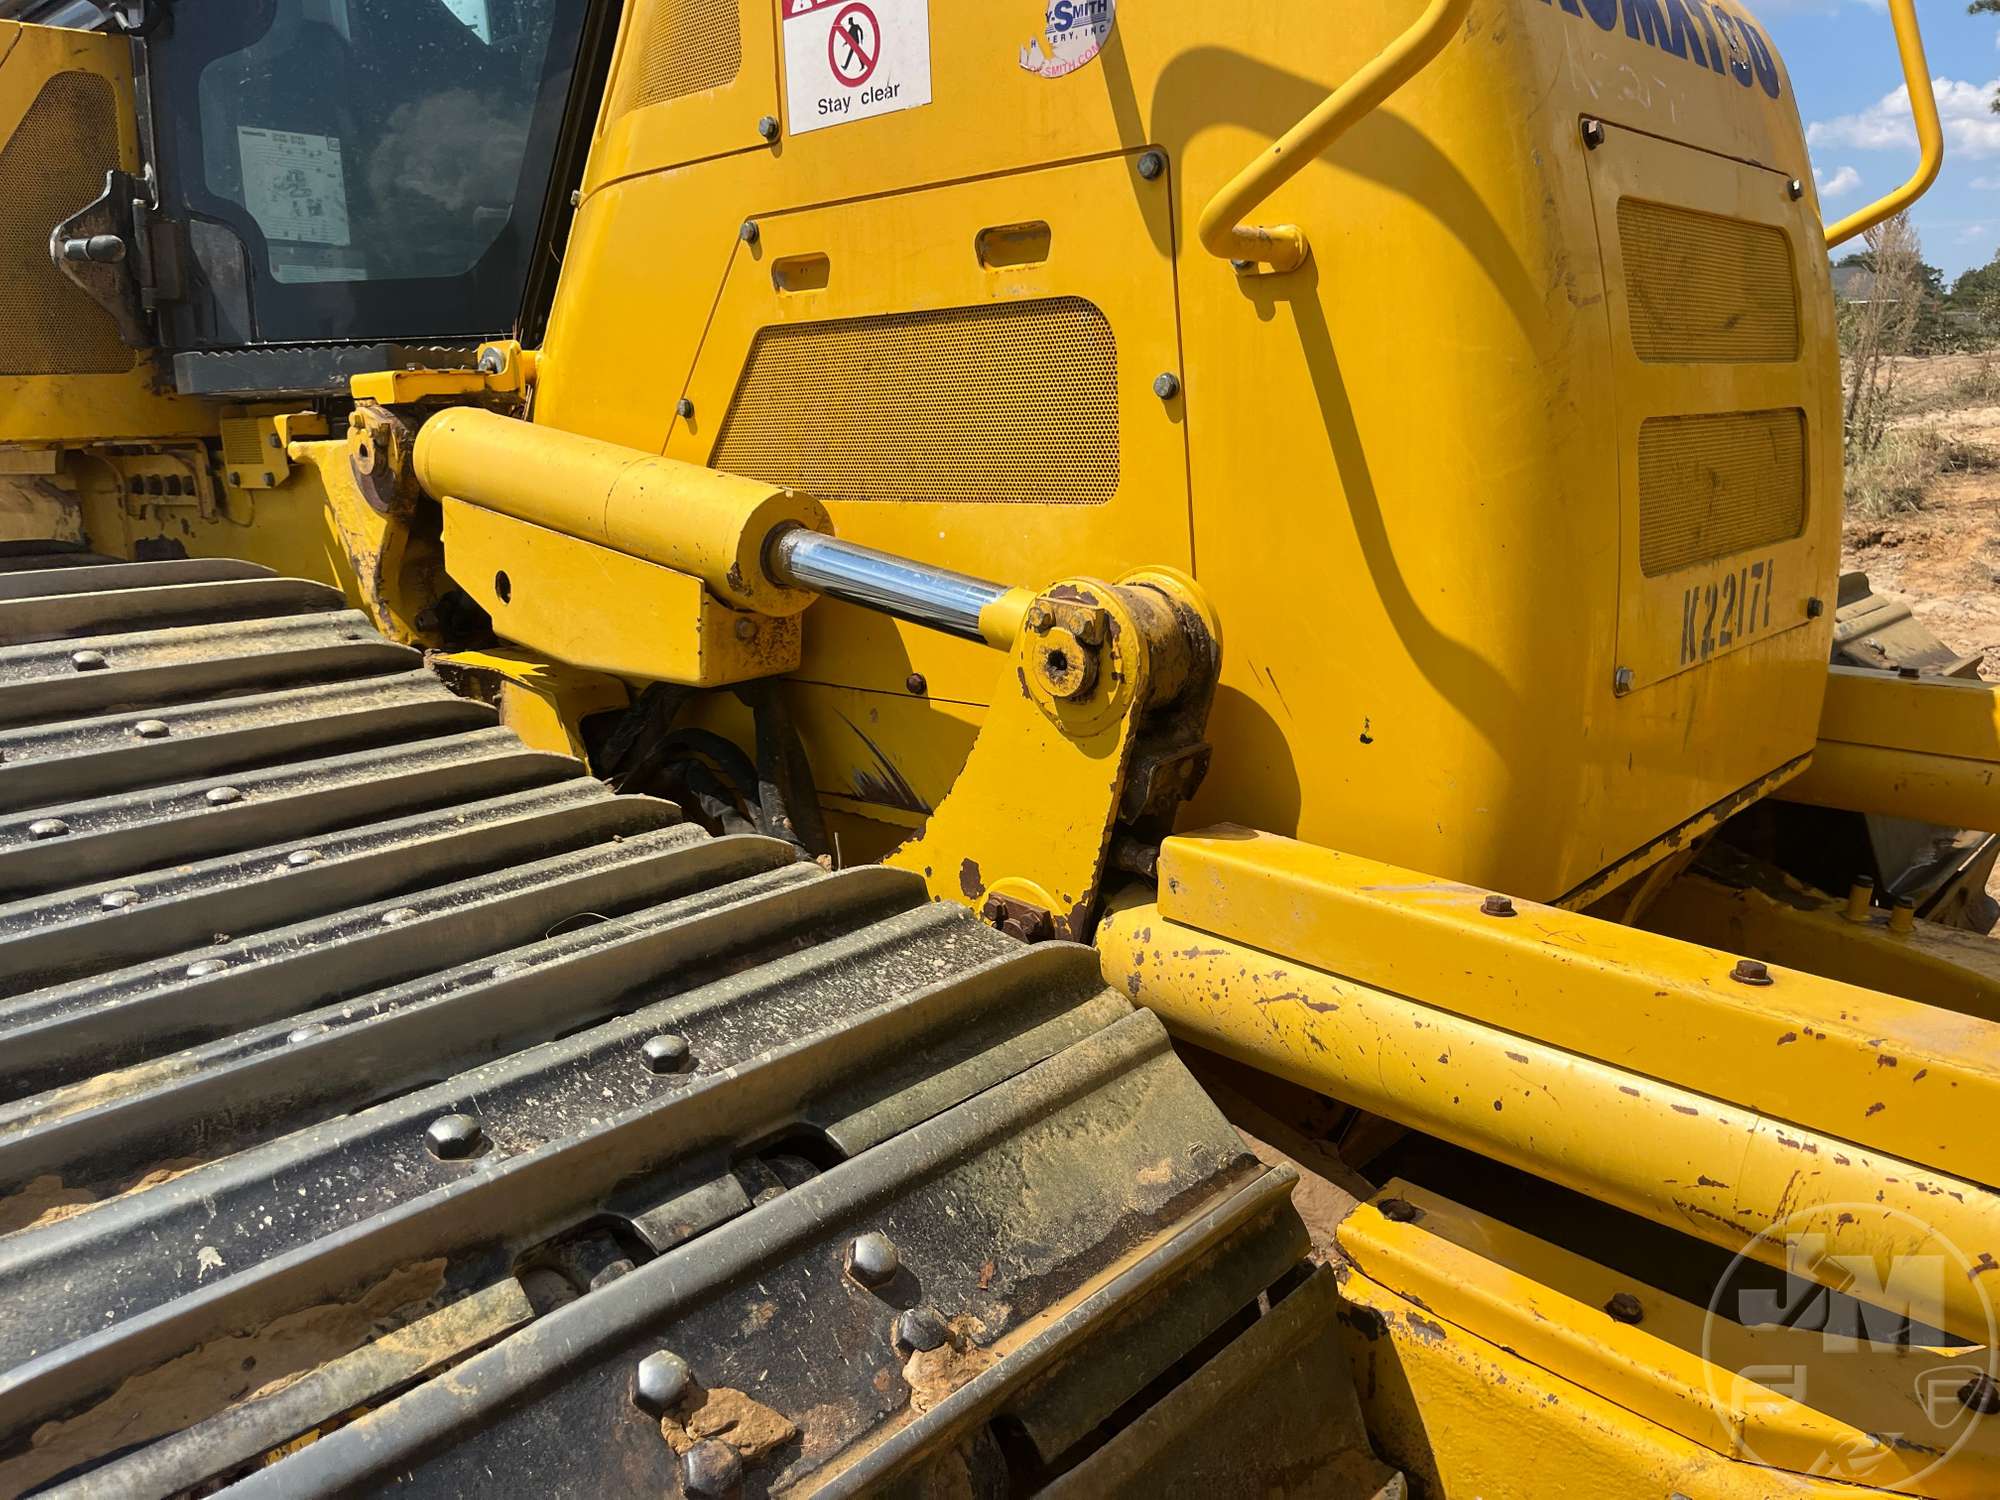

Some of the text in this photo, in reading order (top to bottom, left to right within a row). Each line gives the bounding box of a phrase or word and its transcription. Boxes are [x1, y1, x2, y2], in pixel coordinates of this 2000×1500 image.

[817, 83, 900, 115] Stay clear
[1540, 0, 1780, 99] MATSU
[1680, 558, 1774, 666] K22171
